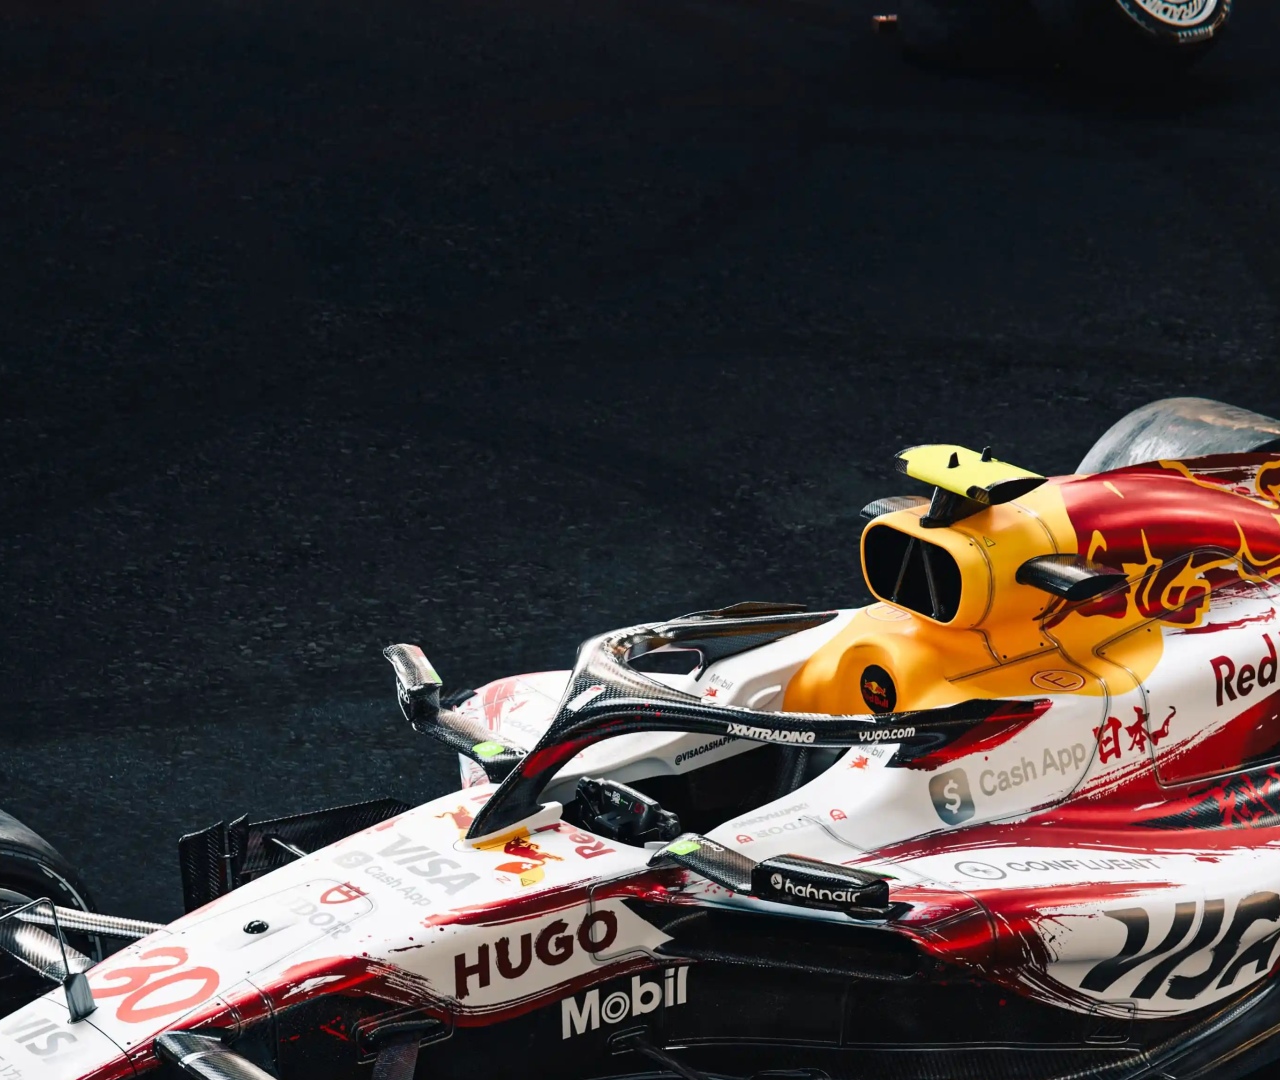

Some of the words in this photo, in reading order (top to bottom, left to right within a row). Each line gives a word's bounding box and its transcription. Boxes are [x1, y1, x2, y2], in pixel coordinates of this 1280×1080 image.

[1210, 637, 1279, 708] Red
[732, 722, 816, 744] XMTRADING
[858, 726, 916, 748] yugo.com
[979, 755, 1039, 798] Cash
[1042, 743, 1087, 782] App
[364, 865, 402, 890] Cash
[396, 882, 432, 907] App
[376, 833, 481, 896] VISA
[785, 879, 860, 903] hahnair
[1006, 857, 1161, 873] CONFLUENT
[453, 909, 618, 999] HUGO
[84, 944, 220, 1023] 30
[560, 966, 689, 1040] Mobil
[1, 1008, 86, 1064] VIS
